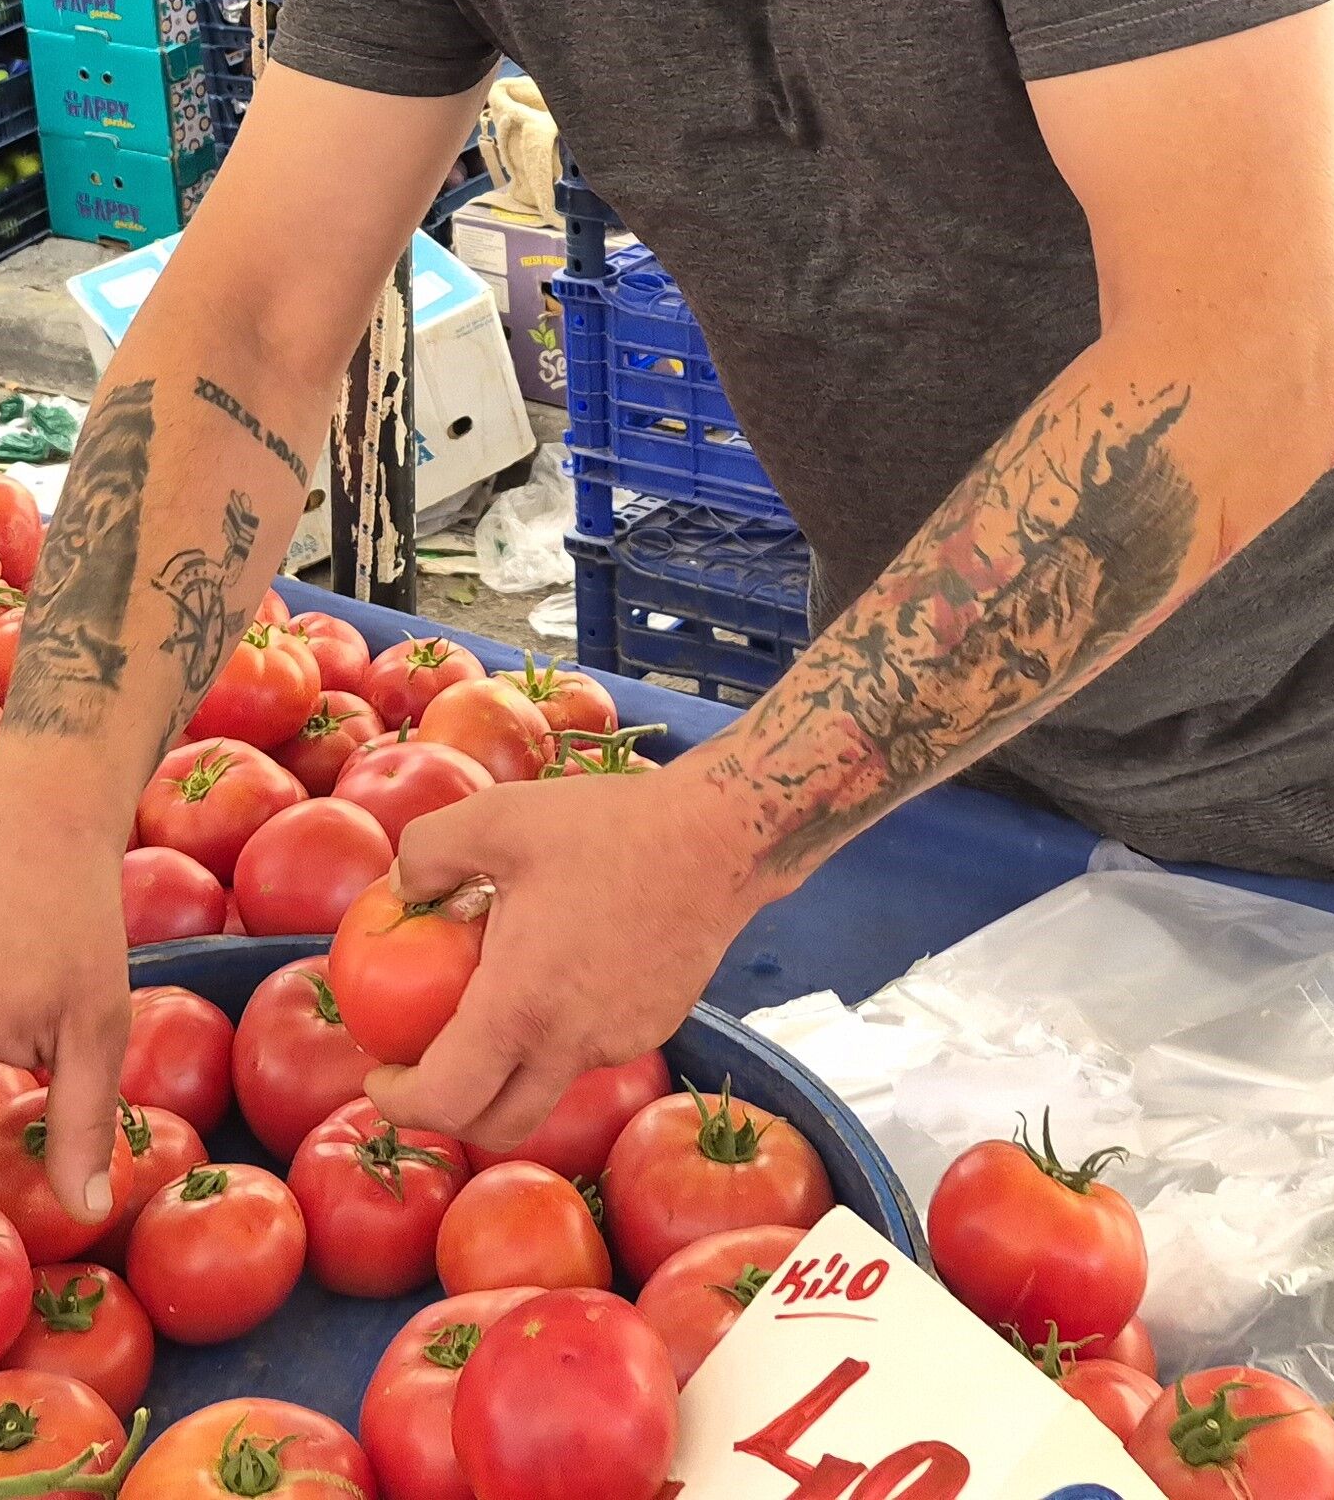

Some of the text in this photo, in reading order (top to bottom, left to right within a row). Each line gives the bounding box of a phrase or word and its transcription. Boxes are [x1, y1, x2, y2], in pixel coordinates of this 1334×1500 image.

[64, 90, 129, 122] HAPPY
[76, 191, 140, 223] HAPPY
[539, 349, 567, 384] Se
[733, 1357, 970, 1500] 40
